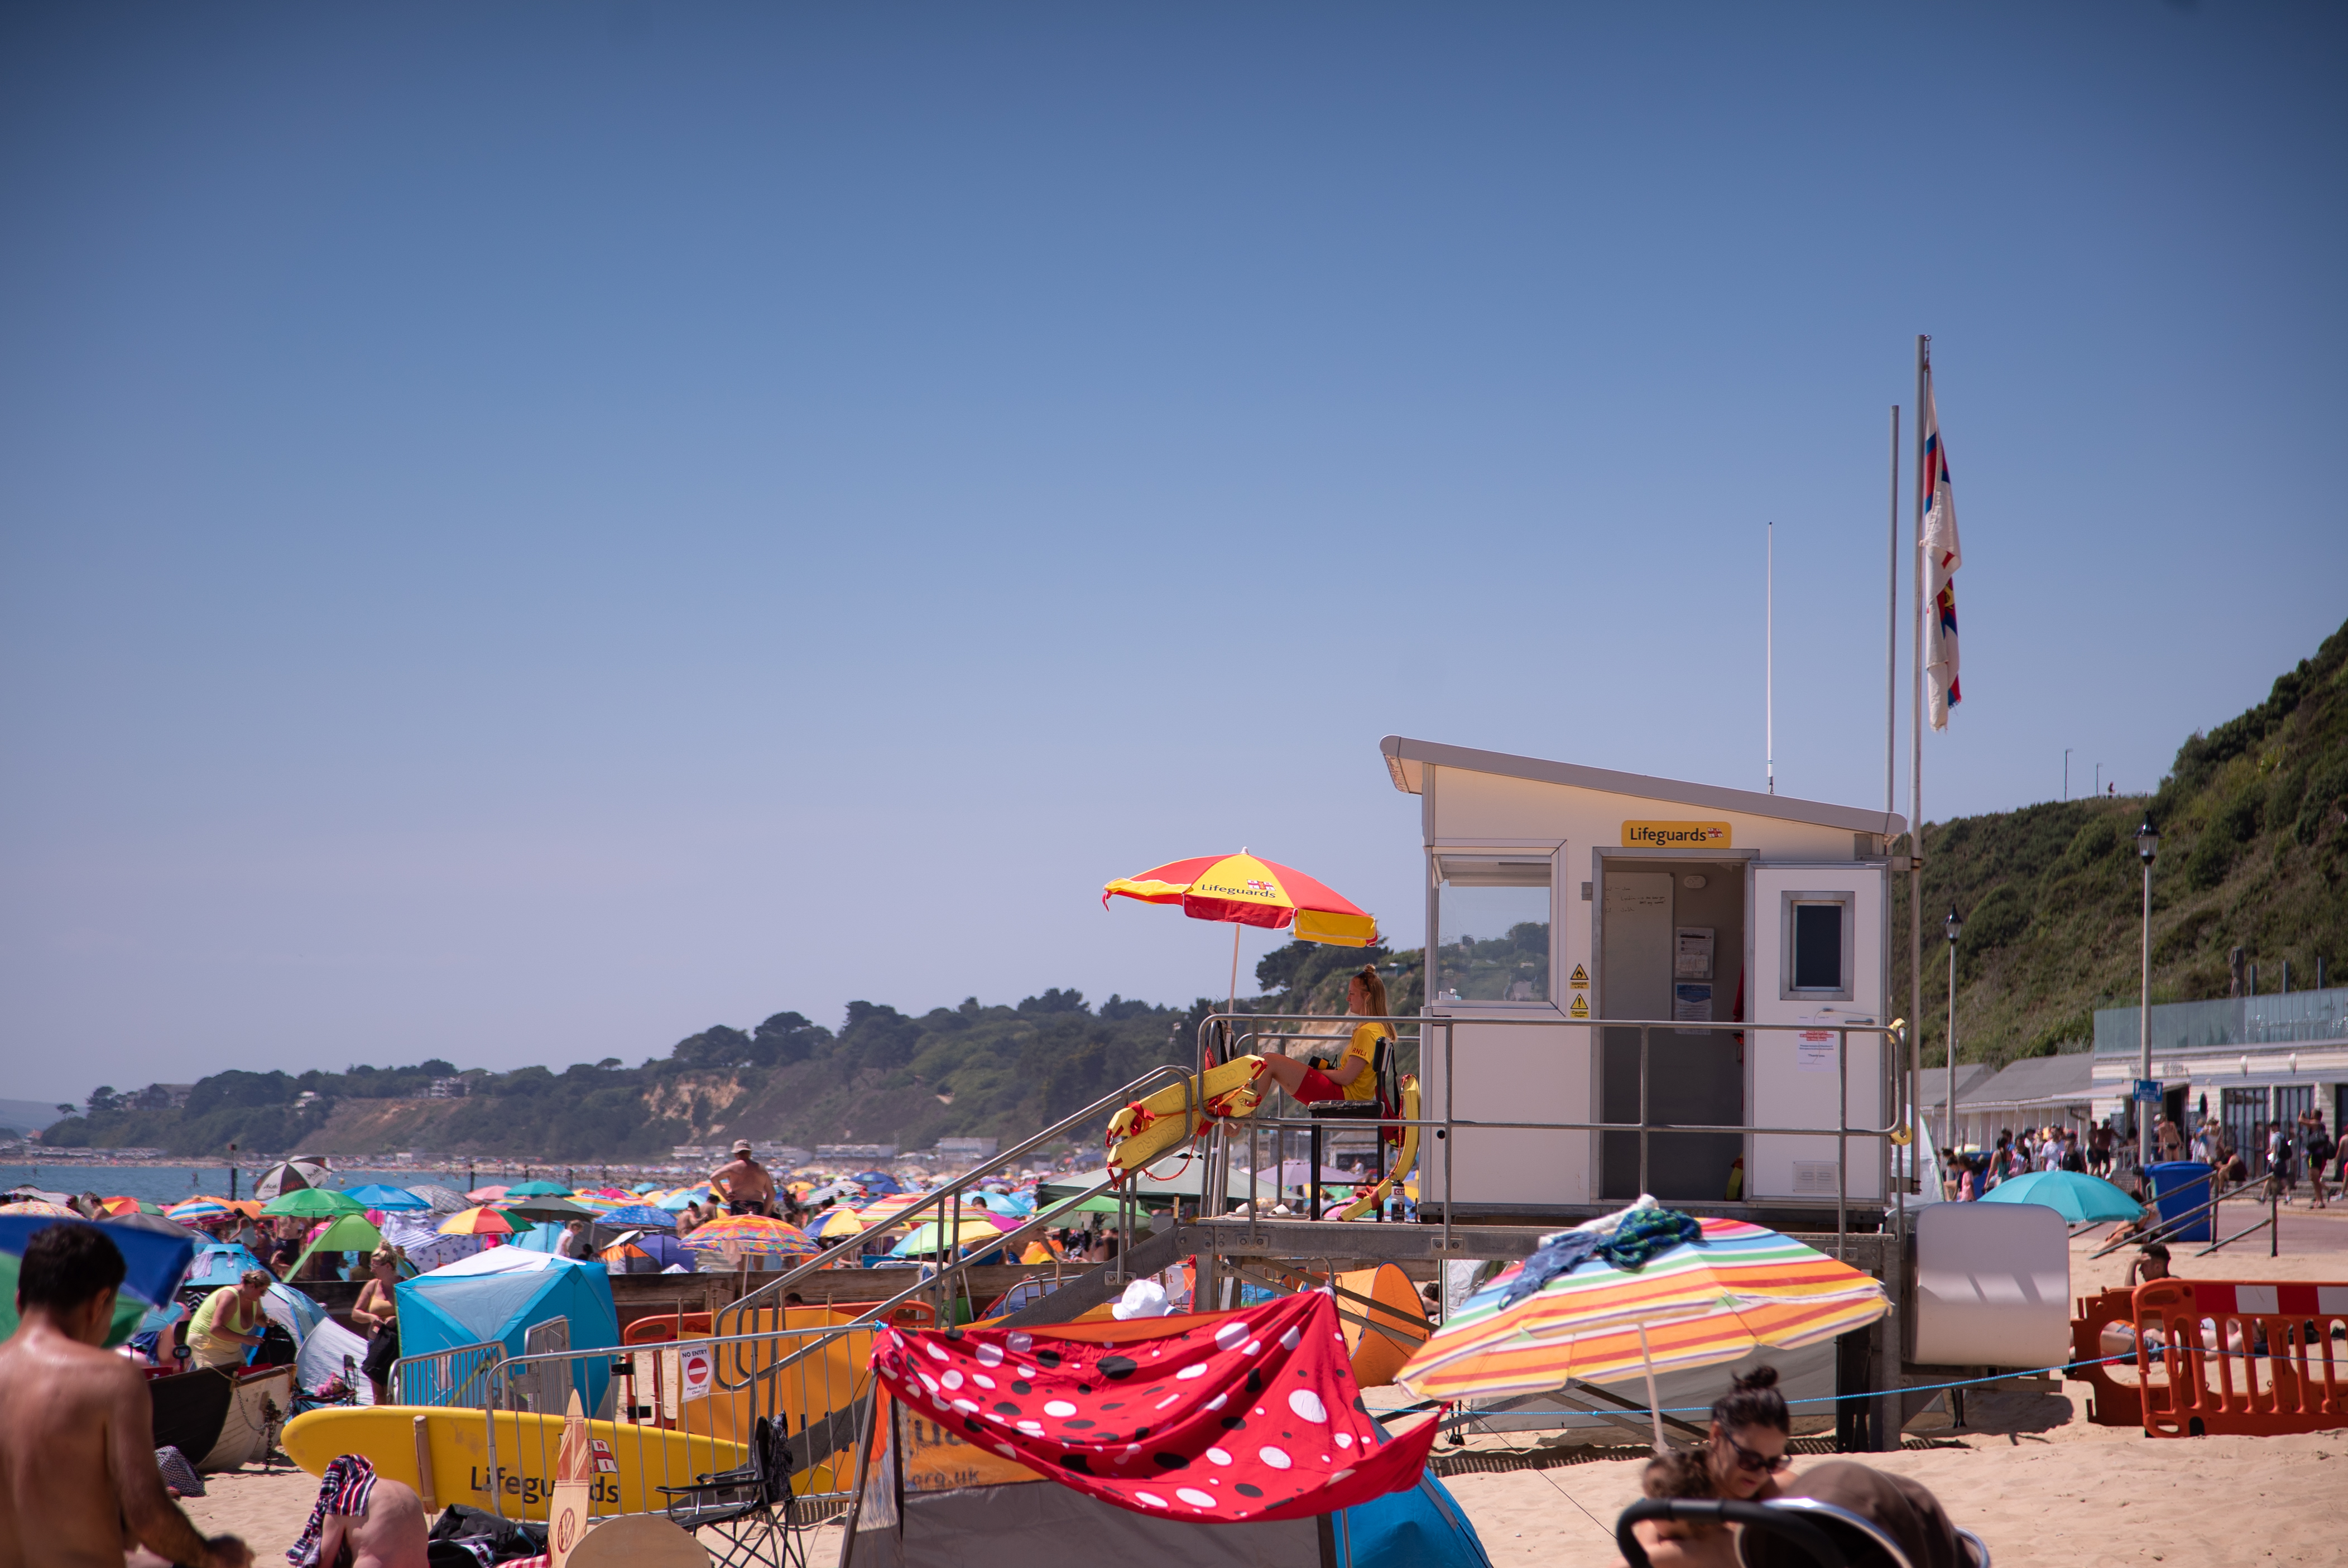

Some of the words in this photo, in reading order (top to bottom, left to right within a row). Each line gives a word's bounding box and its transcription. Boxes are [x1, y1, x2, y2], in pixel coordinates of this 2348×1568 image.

[1630, 827, 1707, 845] Lifeguards
[1201, 883, 1276, 898] Lifeguards
[1352, 1047, 1367, 1057] RNLI
[1150, 1273, 1174, 1284] Eit
[471, 1466, 620, 1504] Lifeguds
